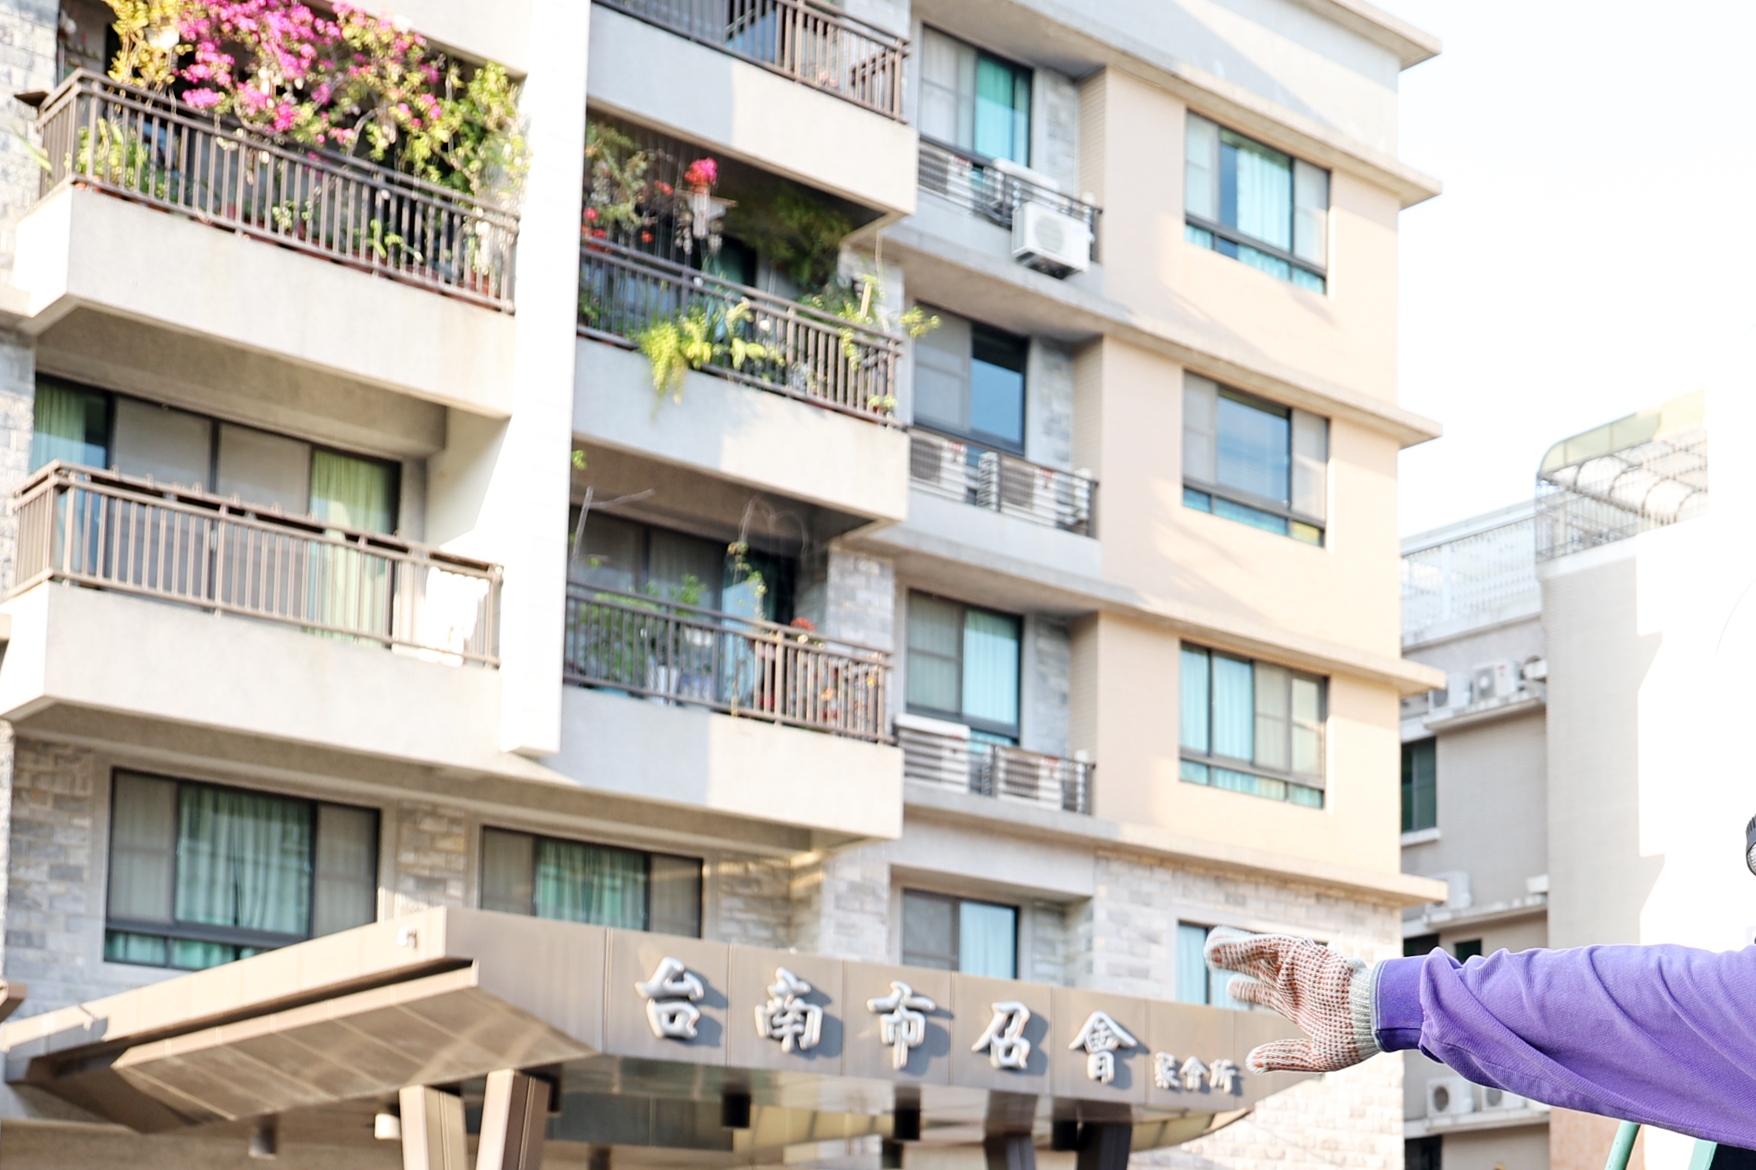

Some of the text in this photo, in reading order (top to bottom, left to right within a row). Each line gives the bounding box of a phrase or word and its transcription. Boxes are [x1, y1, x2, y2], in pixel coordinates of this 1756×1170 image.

[634, 956, 1138, 1085] 台南市召會
